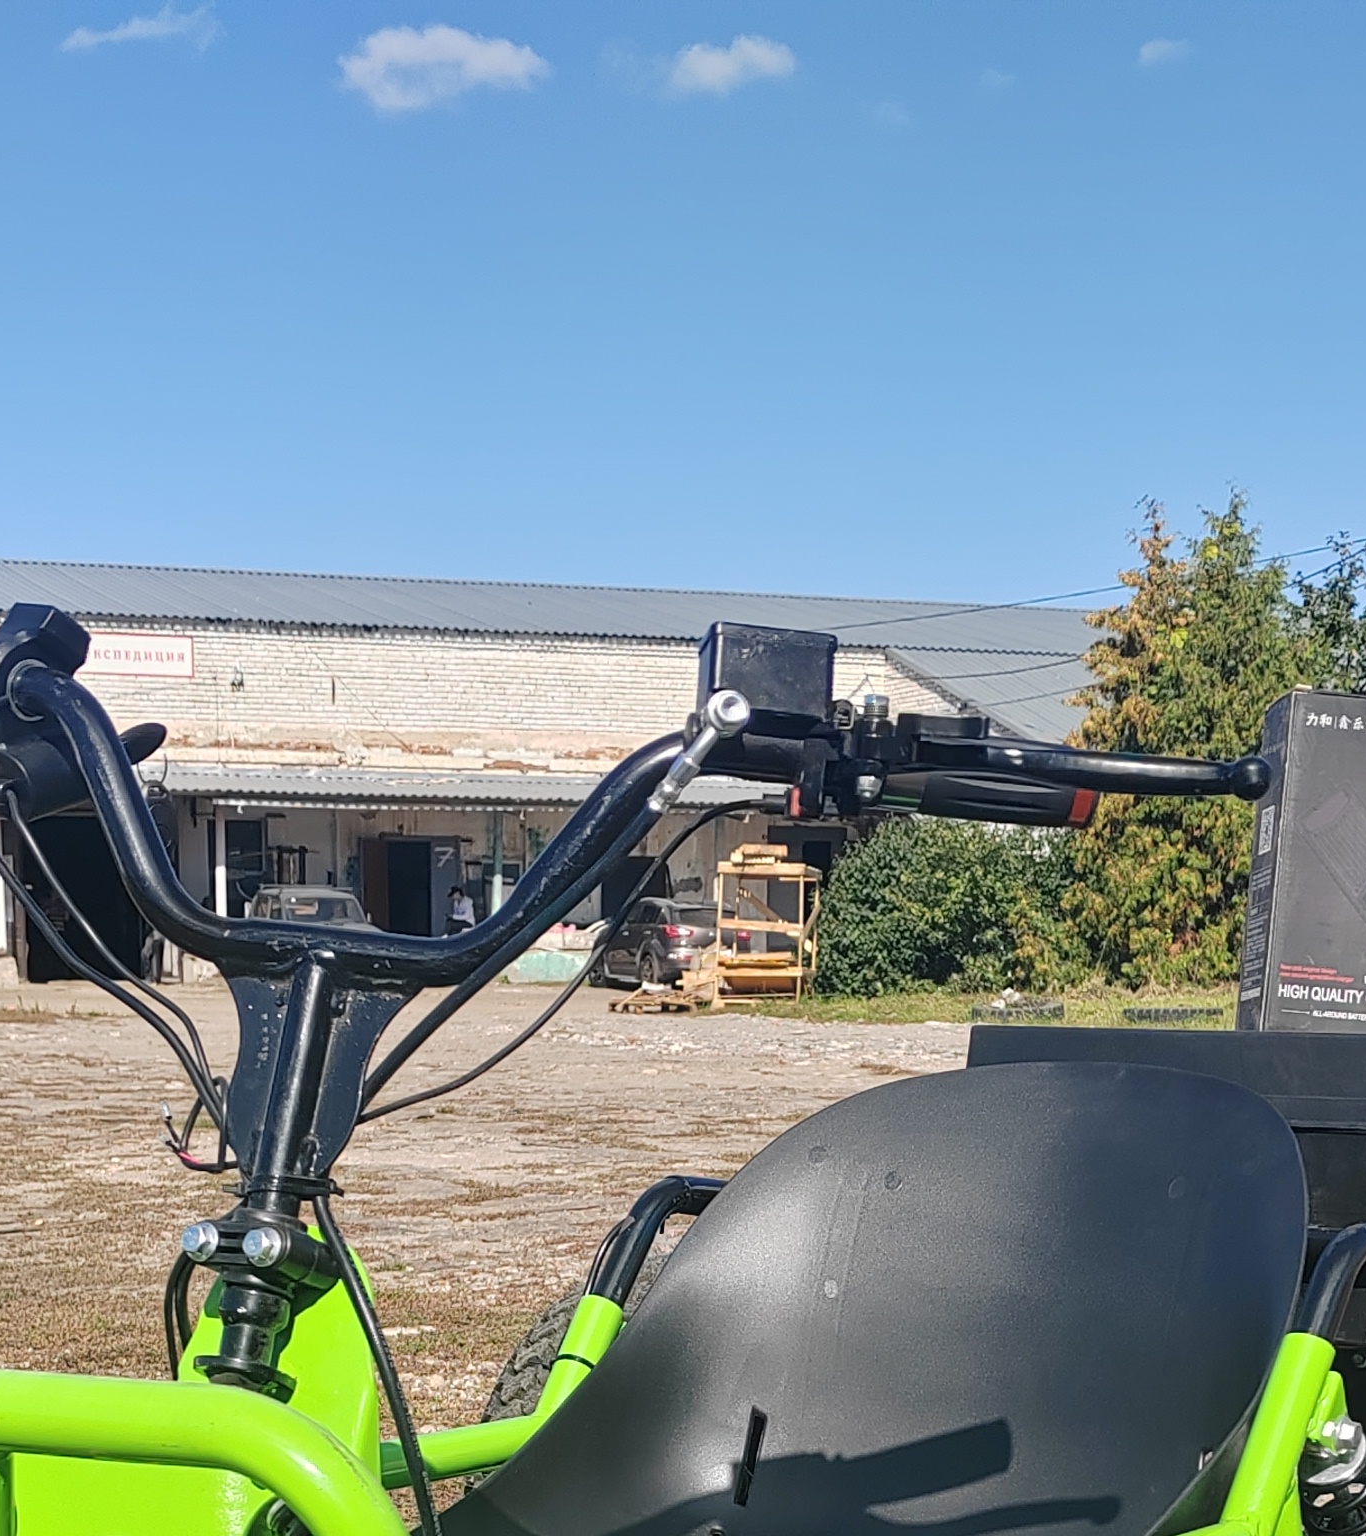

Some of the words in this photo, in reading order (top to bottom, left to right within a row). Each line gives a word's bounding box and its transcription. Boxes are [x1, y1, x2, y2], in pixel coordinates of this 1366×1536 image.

[92, 649, 185, 663] КСПЕДИЦИЯ
[434, 846, 456, 868] 7
[1278, 983, 1308, 1000] HIGH
[1311, 986, 1364, 1004] QUALITY
